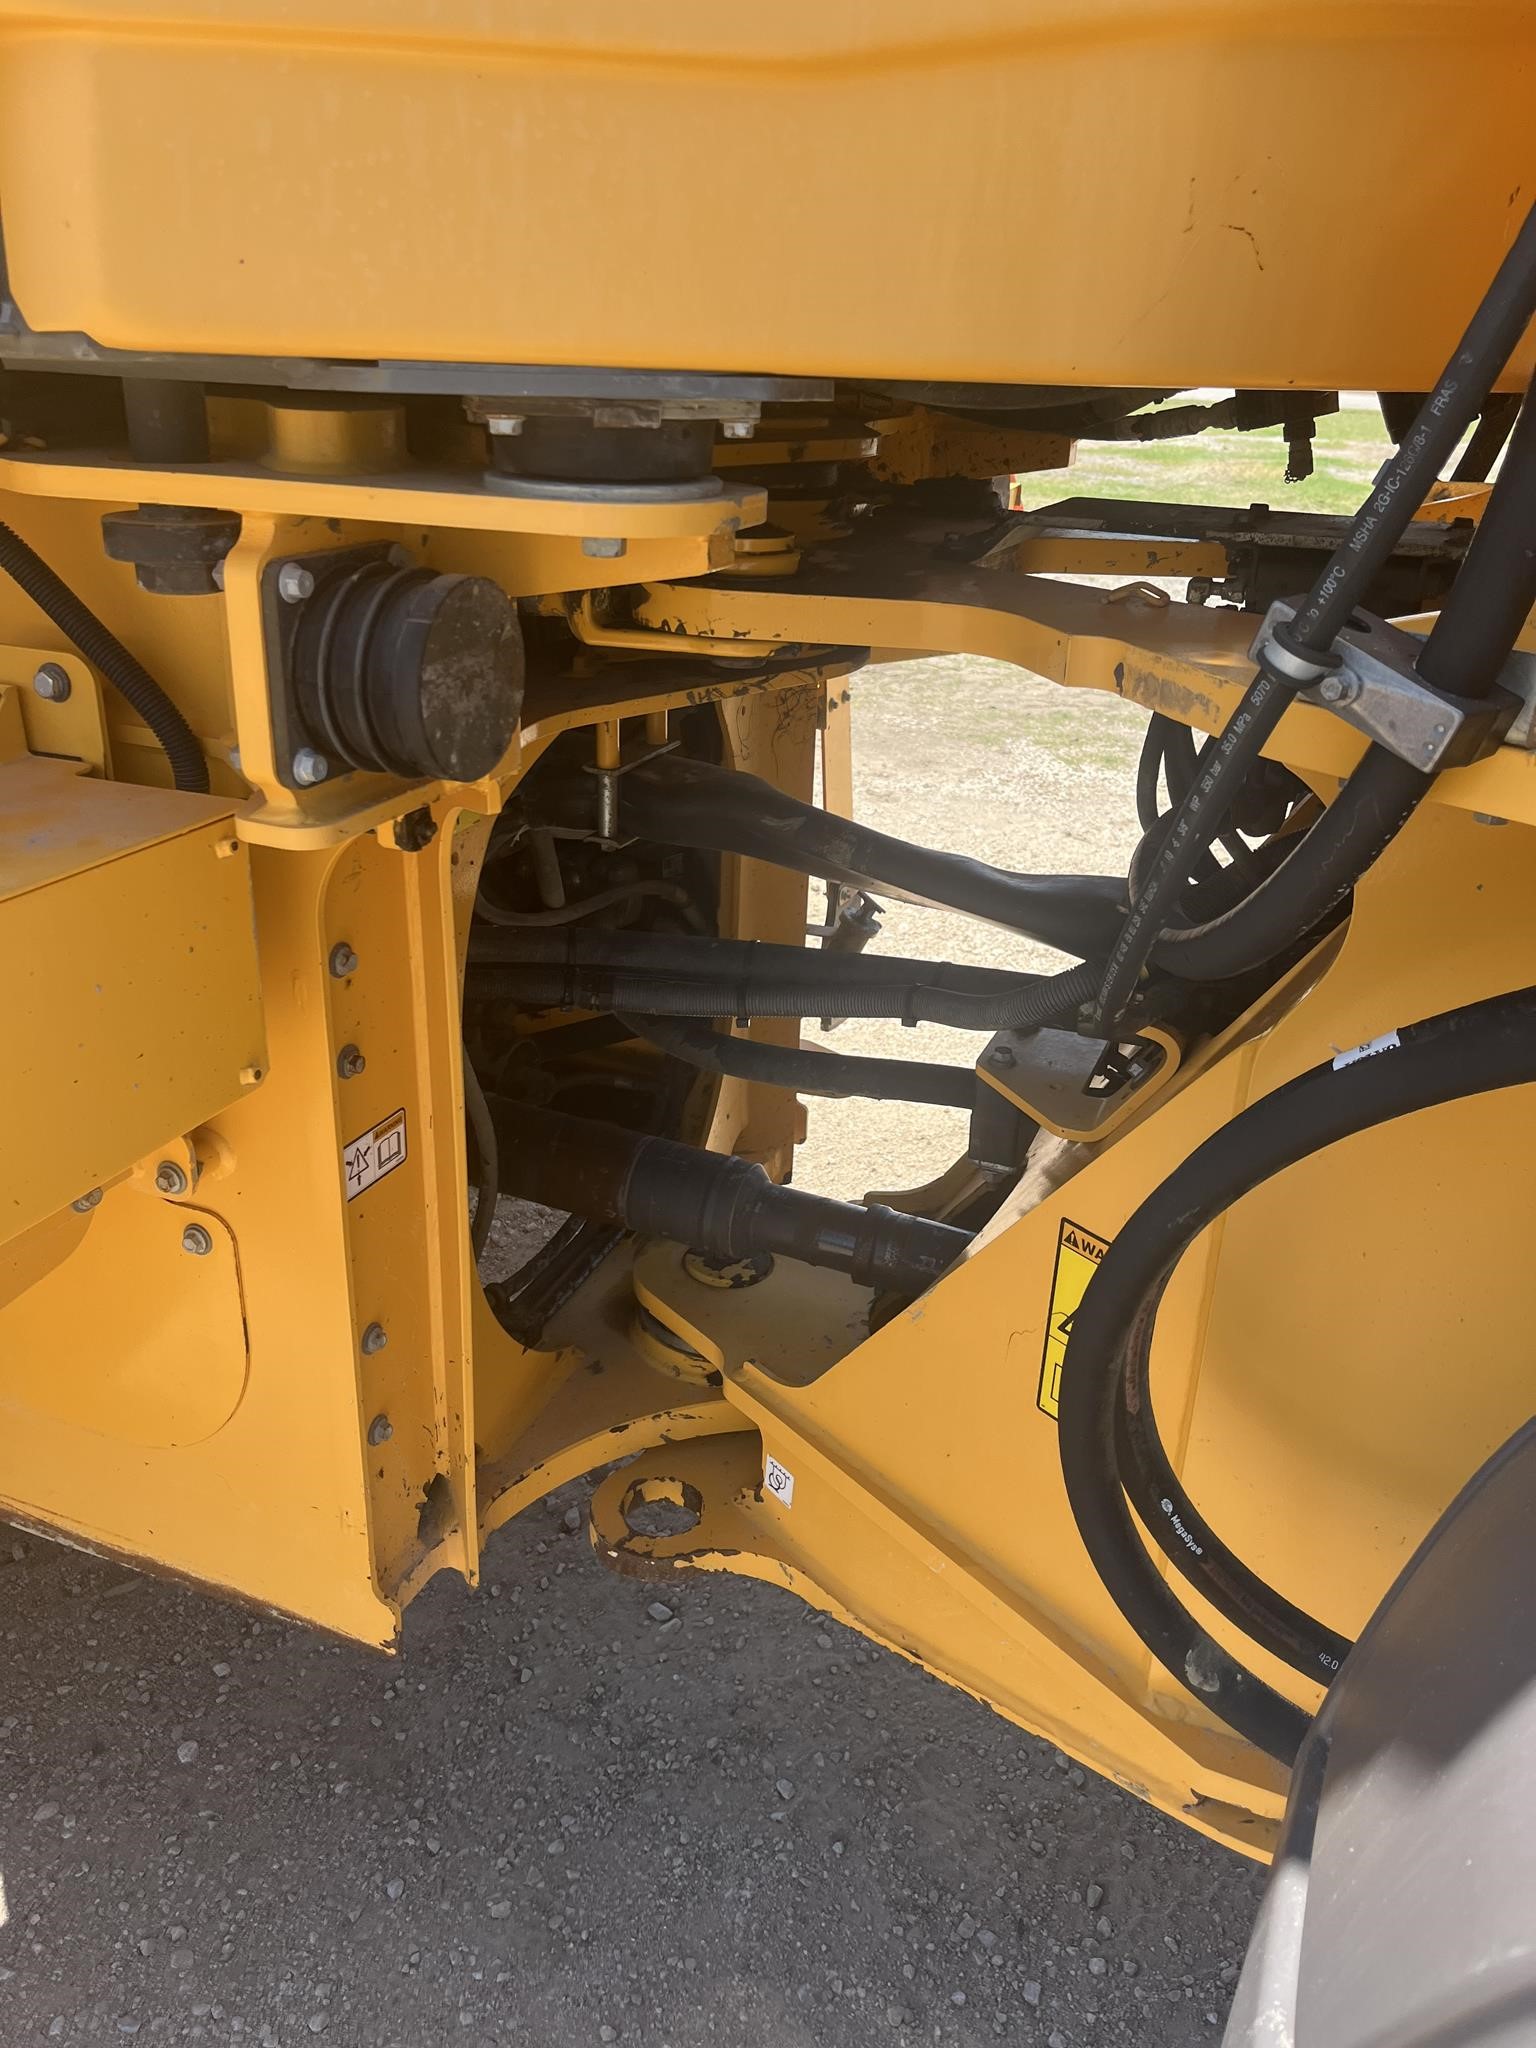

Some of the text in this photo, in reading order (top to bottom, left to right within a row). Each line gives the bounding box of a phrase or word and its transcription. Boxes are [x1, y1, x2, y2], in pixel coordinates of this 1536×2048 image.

[1234, 711, 1252, 736] MPa
[1249, 678, 1271, 707] 5070
[1348, 514, 1378, 553] MSHA
[1430, 379, 1458, 417] FRAS
[1317, 1652, 1340, 1671] 42.0
